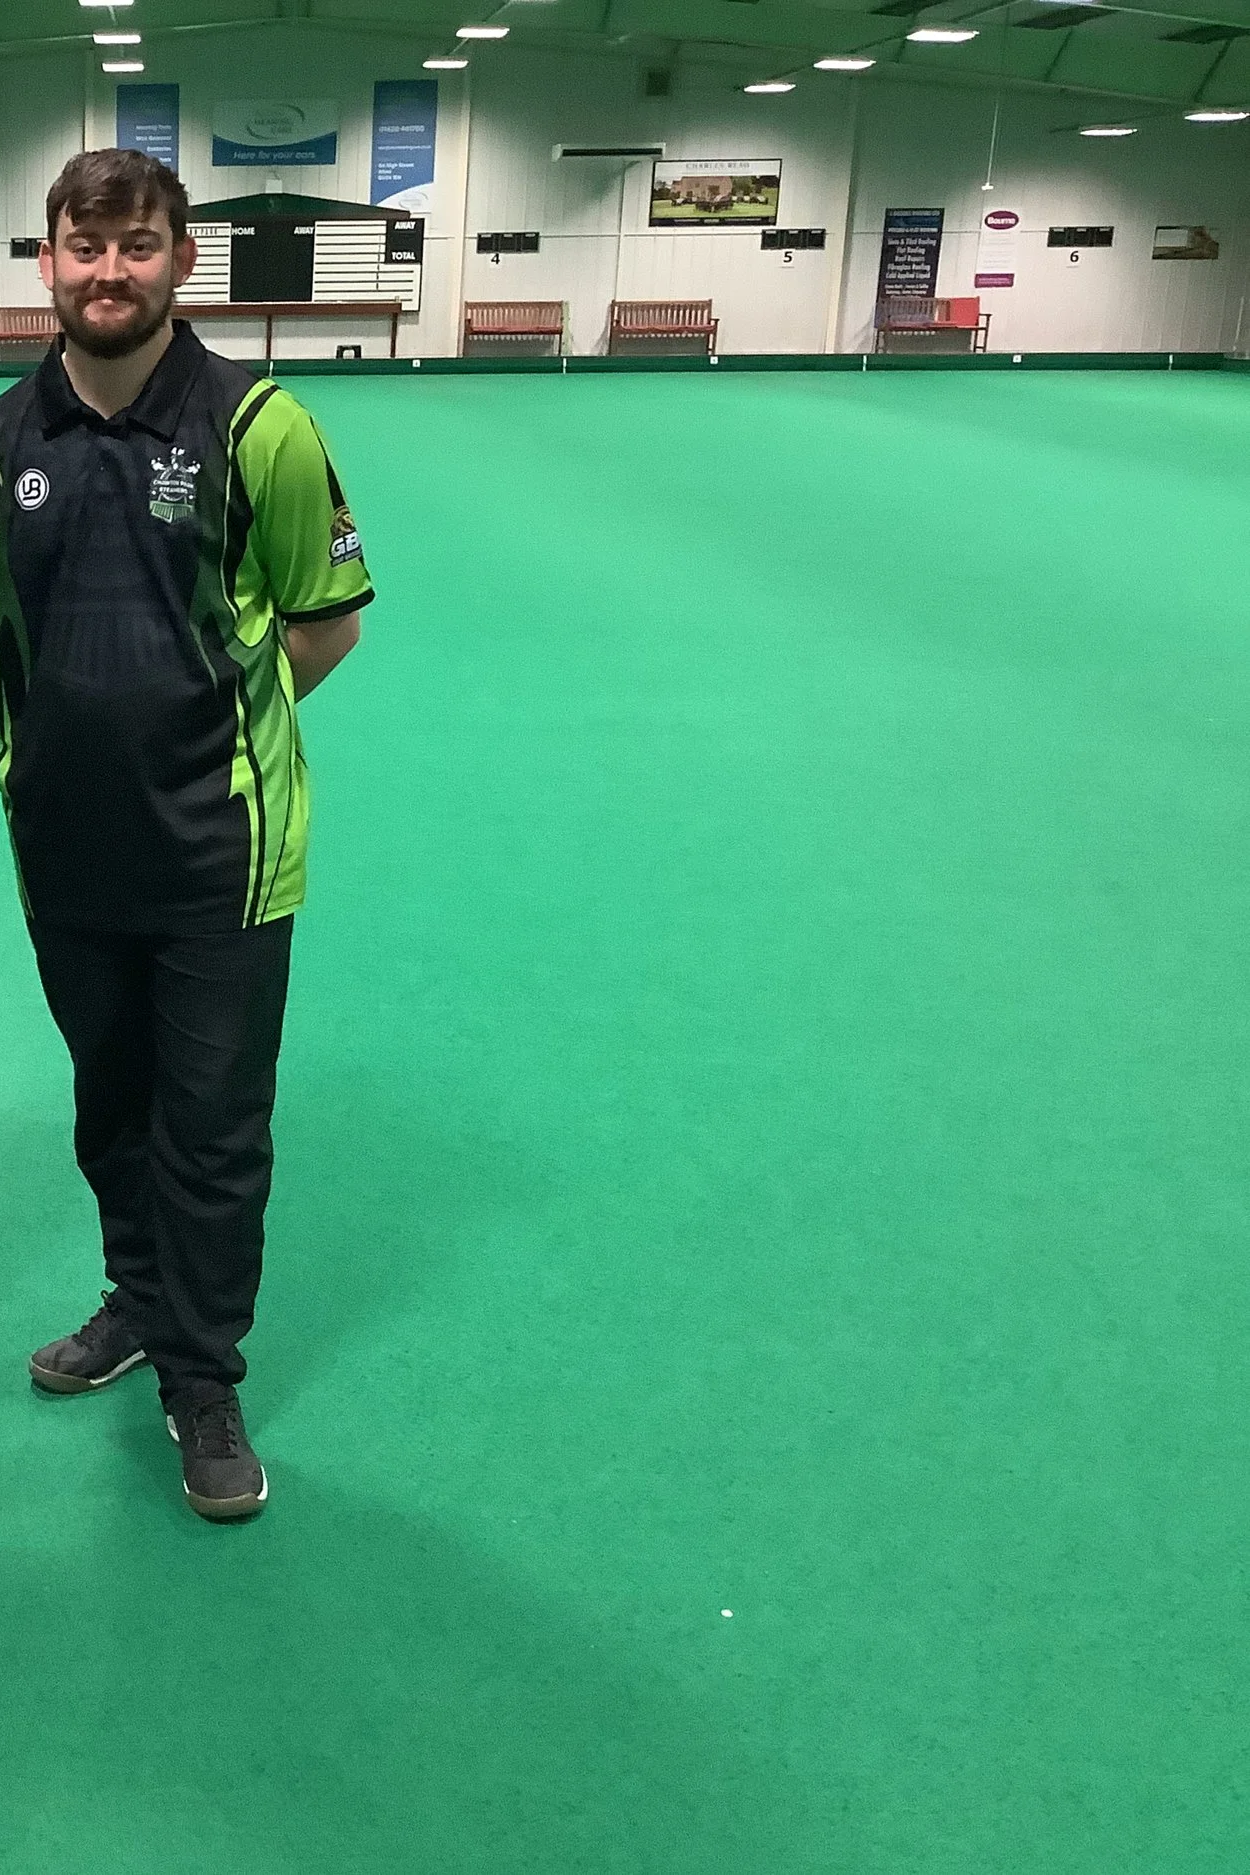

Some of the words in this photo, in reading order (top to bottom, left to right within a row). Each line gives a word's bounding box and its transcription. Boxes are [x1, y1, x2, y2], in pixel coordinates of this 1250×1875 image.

[987, 216, 1016, 225] Bourne
[394, 221, 416, 230] AWAY
[231, 226, 256, 236] HOME
[293, 226, 315, 235] AWAY
[907, 246, 926, 254] Roofing
[391, 251, 416, 260] TOTAL
[490, 252, 500, 265] 4
[783, 251, 793, 263] 5
[1070, 250, 1079, 263] 6
[912, 263, 930, 271] Roofing
